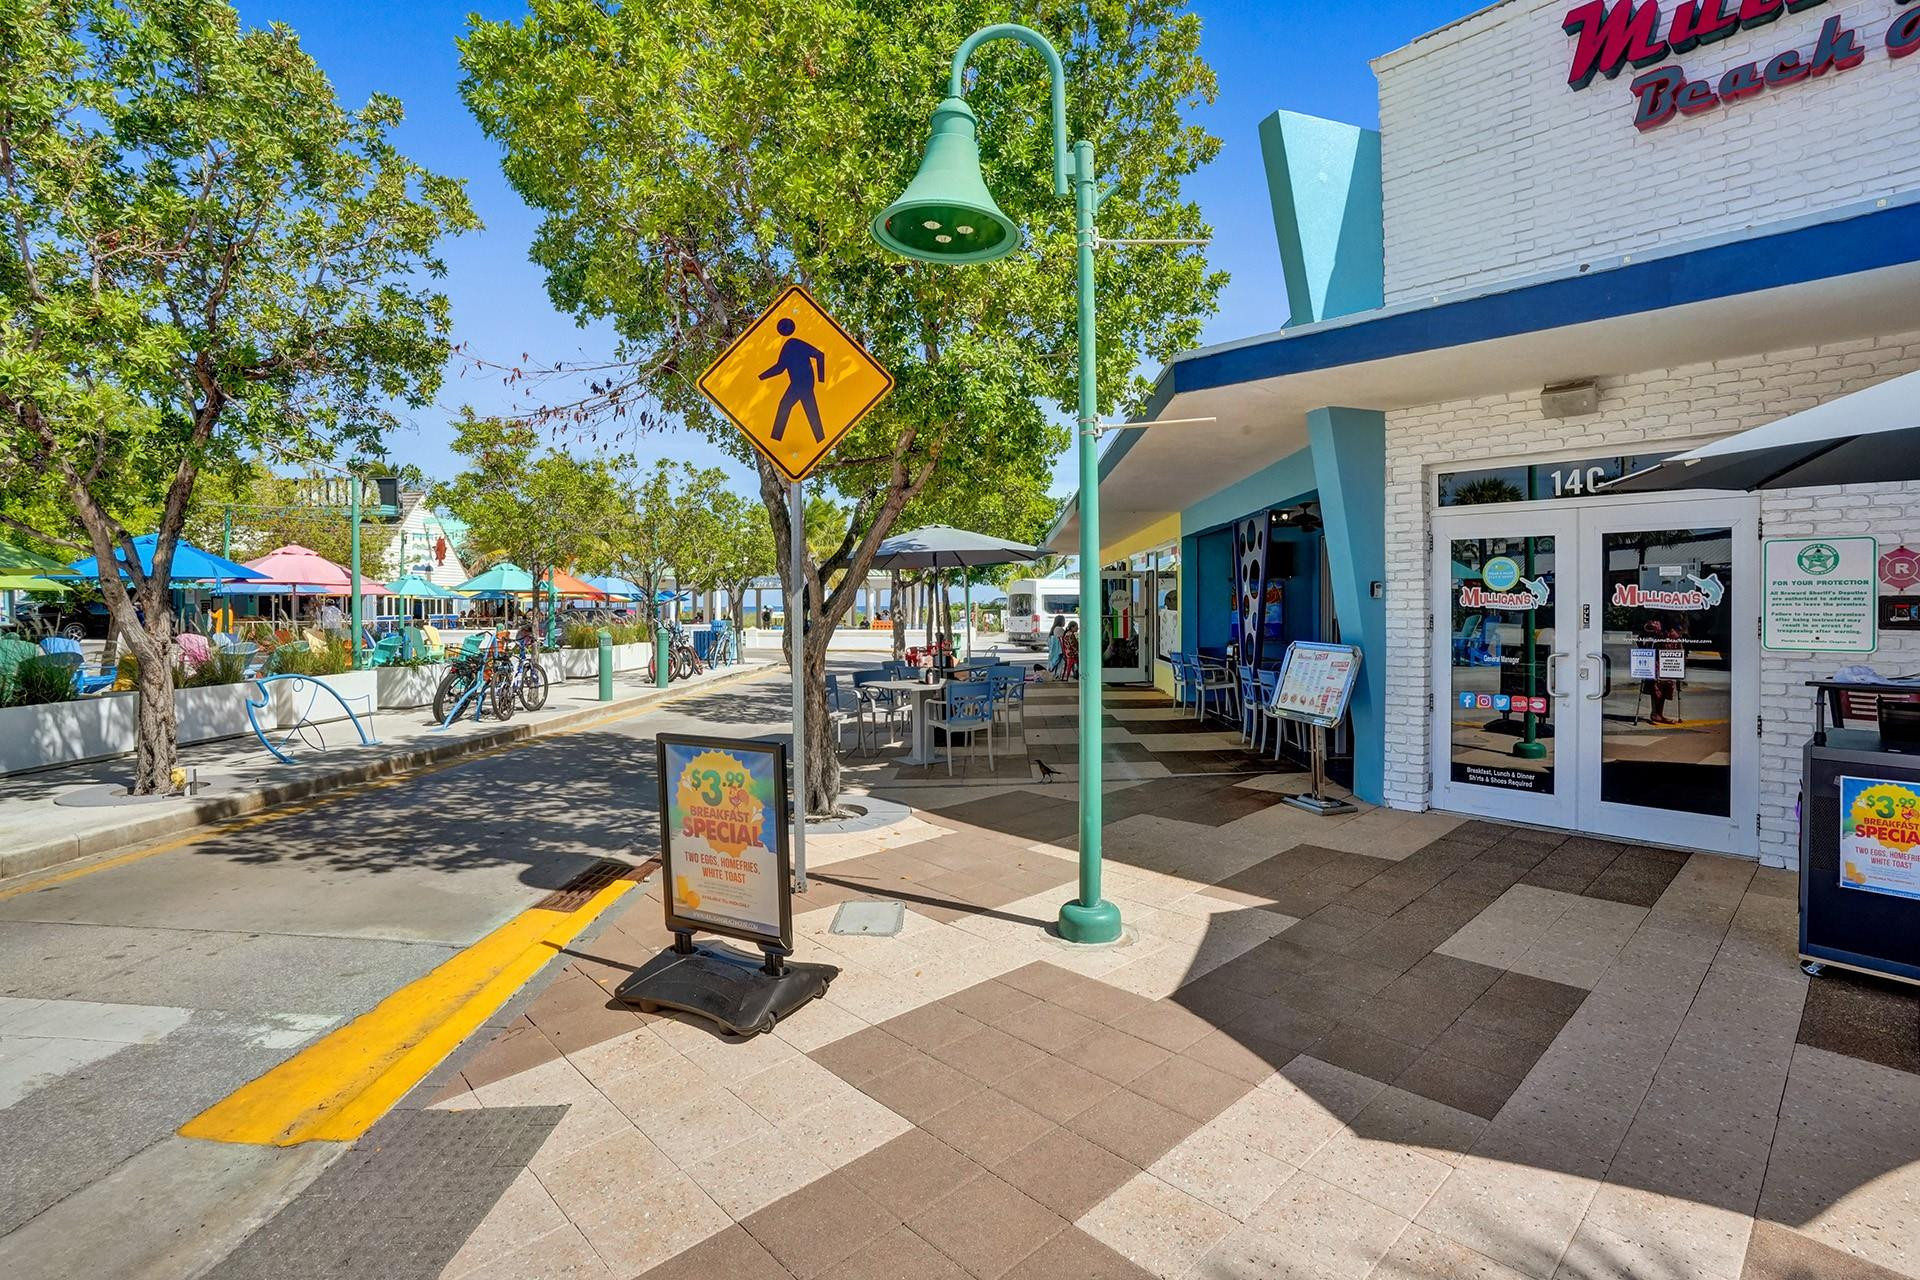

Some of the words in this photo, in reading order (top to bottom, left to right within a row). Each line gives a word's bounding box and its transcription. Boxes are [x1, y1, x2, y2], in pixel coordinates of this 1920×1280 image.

[1562, 0, 1829, 92] Mu
[1630, 14, 1865, 134] Beach
[1895, 563, 1909, 574] R
[1460, 586, 1532, 607] MULLIGAN'S
[1613, 584, 1702, 606] MULLIGAN'S
[1501, 656, 1520, 665] Manager
[1466, 766, 1492, 775] Breakfast,
[1494, 770, 1510, 778] Lunch
[1516, 772, 1535, 780] Dinner
[1491, 777, 1507, 785] Shoes
[1508, 778, 1533, 788] Required
[692, 769, 745, 807] $3.99
[690, 806, 750, 823] BREAKFAST
[1866, 795, 1916, 819] $3.99
[682, 816, 764, 848] SPECIAL
[1864, 818, 1920, 831] BREAKFAST
[1855, 824, 1920, 845] SPECIA
[685, 851, 699, 863] TWO
[701, 853, 719, 867] EGGS,
[720, 856, 761, 874] HOMEFRIES,
[1856, 846, 1869, 855] TWO
[1870, 848, 1888, 858] EGGS,
[1890, 851, 1920, 864] HOMEFRIE
[1871, 857, 1890, 866] WHITE
[1892, 860, 1912, 869] TOAST
[702, 867, 723, 880] WHITE
[724, 869, 746, 884] TOAST
